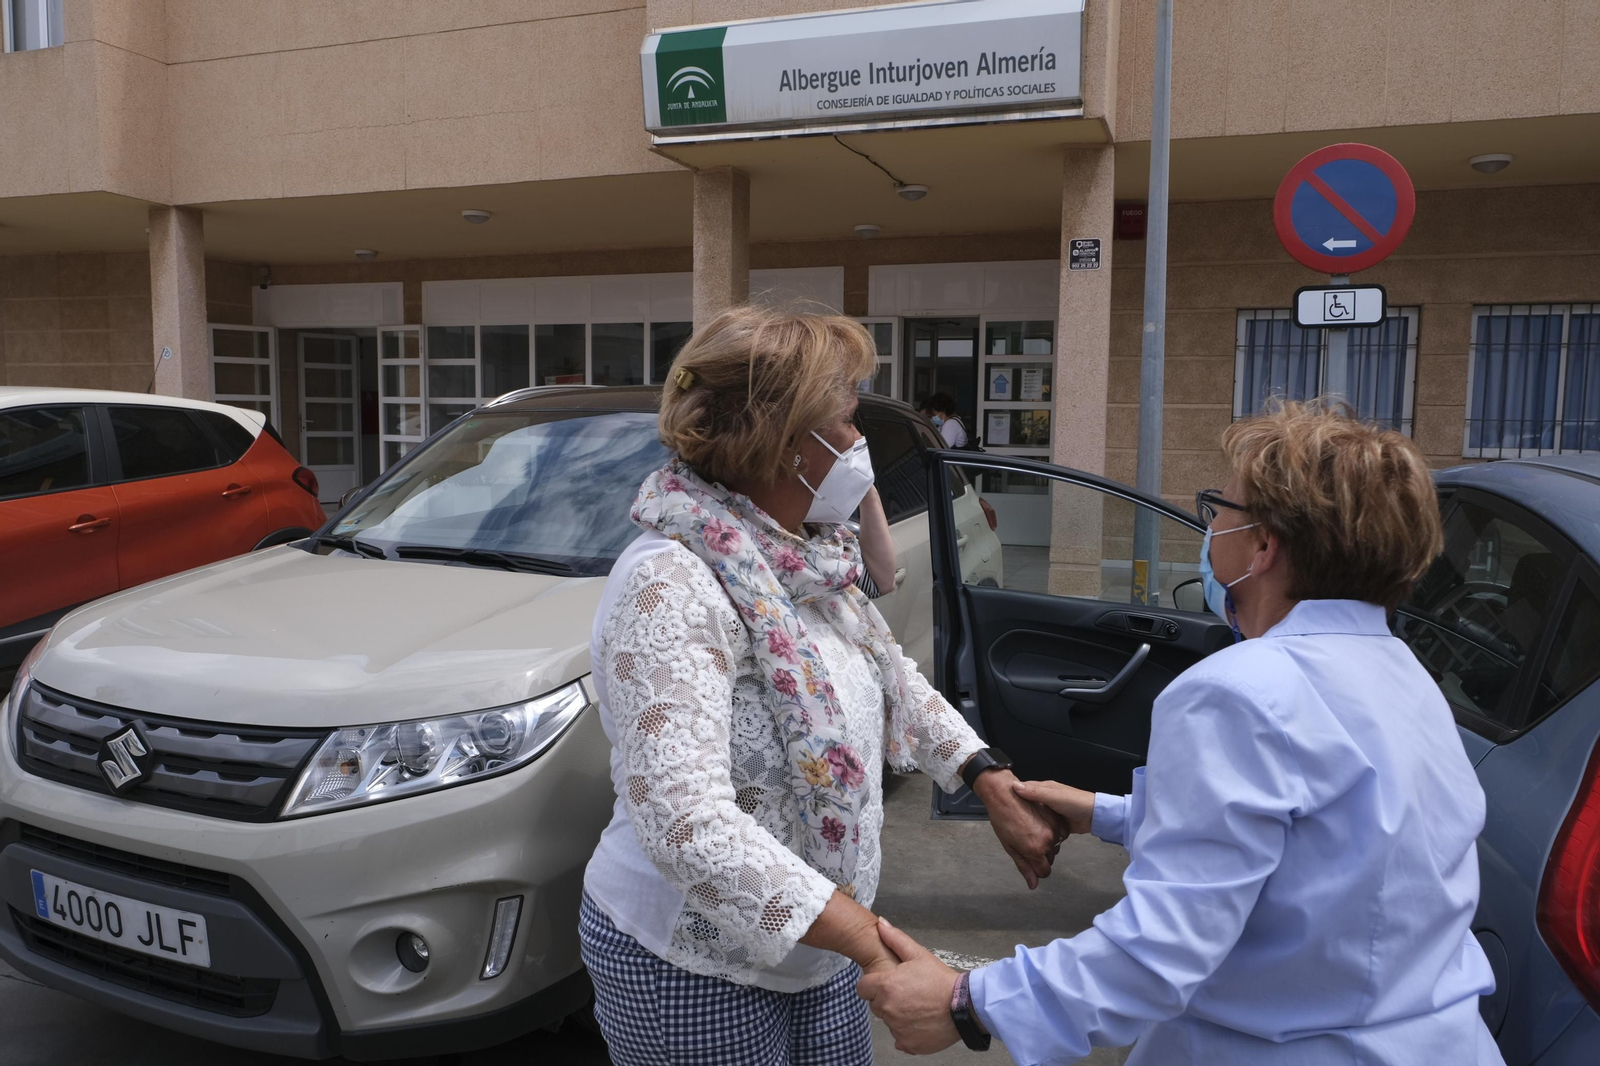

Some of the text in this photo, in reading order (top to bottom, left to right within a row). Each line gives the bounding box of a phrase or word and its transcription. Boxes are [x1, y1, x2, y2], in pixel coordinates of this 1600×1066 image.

[779, 46, 1056, 93] Albergue Inturjoven Almería
[667, 99, 718, 110] JUNTA DE ANDALUCIA
[816, 82, 1056, 110] CONSEJERÍA DE IGUALDAD Y POLÍTICAS SOCIALES
[53, 884, 197, 956] 4000 JLF
